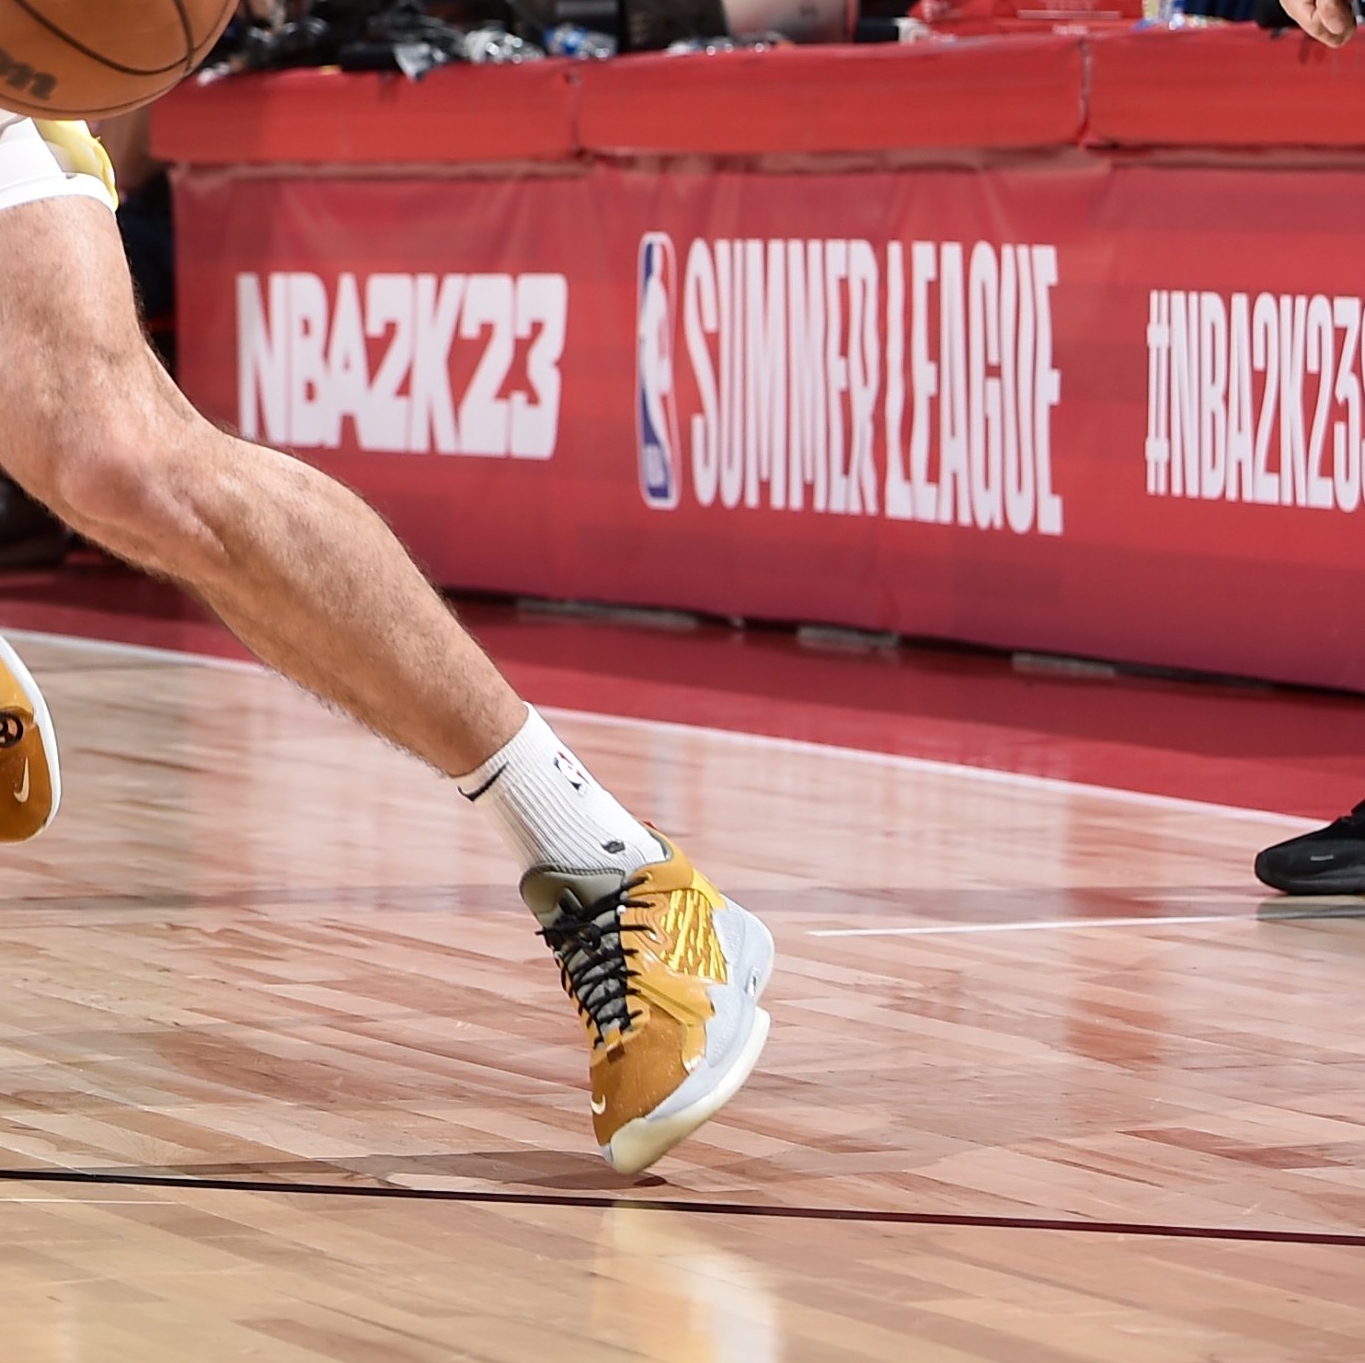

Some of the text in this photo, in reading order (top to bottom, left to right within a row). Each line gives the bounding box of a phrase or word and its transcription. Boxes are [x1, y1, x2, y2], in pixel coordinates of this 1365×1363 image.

[235, 270, 568, 461] NBA2K23
[683, 237, 1064, 536] SUMMER LEAGUE
[1144, 288, 1365, 513] #NBA2K23
